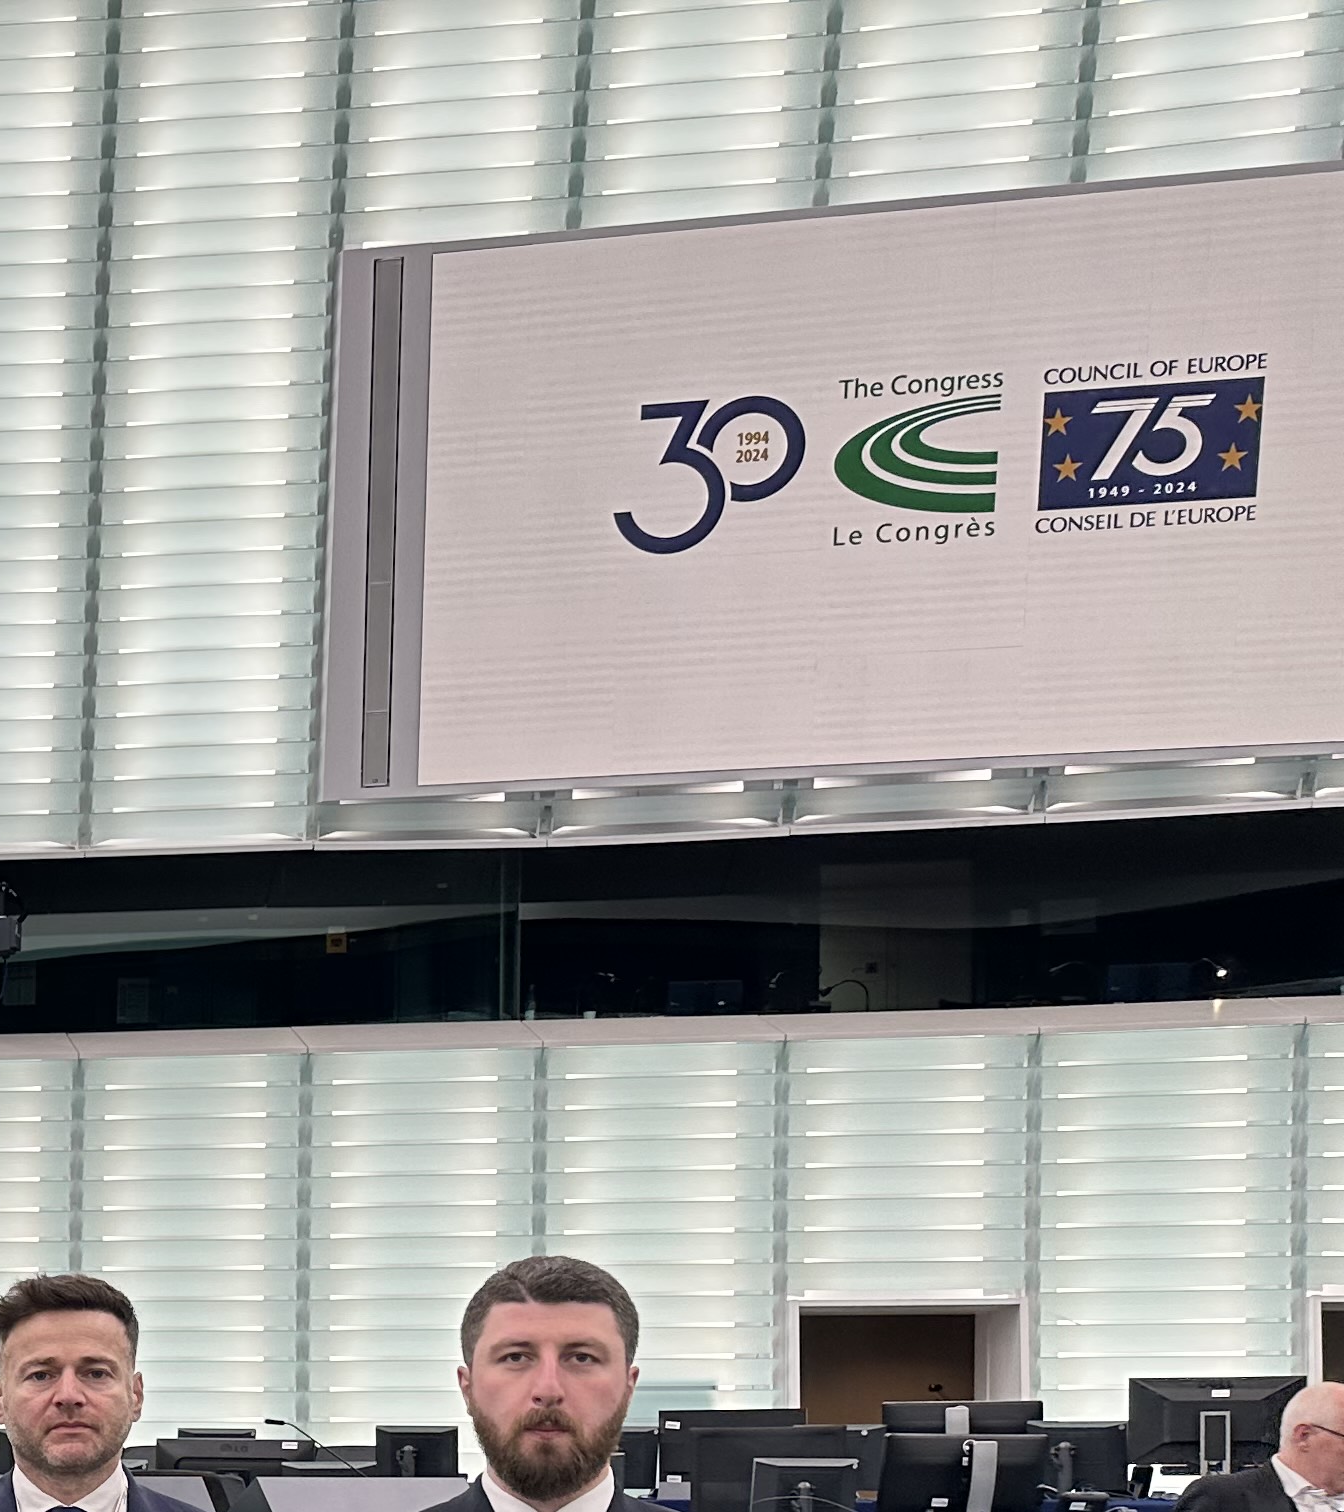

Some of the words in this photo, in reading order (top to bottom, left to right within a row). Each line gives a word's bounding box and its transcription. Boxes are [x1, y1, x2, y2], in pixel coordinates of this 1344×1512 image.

[1044, 362, 1143, 385] COUNCIL
[1150, 360, 1179, 377] OF
[1187, 353, 1268, 374] EUROPE
[839, 378, 883, 399] The
[891, 372, 1004, 397] Congress
[737, 431, 769, 446] 1994
[1090, 393, 1217, 481] 75
[736, 448, 769, 463] 2024
[613, 396, 806, 554] 30
[1088, 485, 1130, 499] 1949
[1154, 481, 1198, 495] 2024
[833, 527, 863, 546] Le
[876, 517, 995, 545] Congrès
[1035, 514, 1123, 534] CONSEIL
[1130, 511, 1157, 528] DE
[1163, 505, 1257, 527] L'EUROPE
